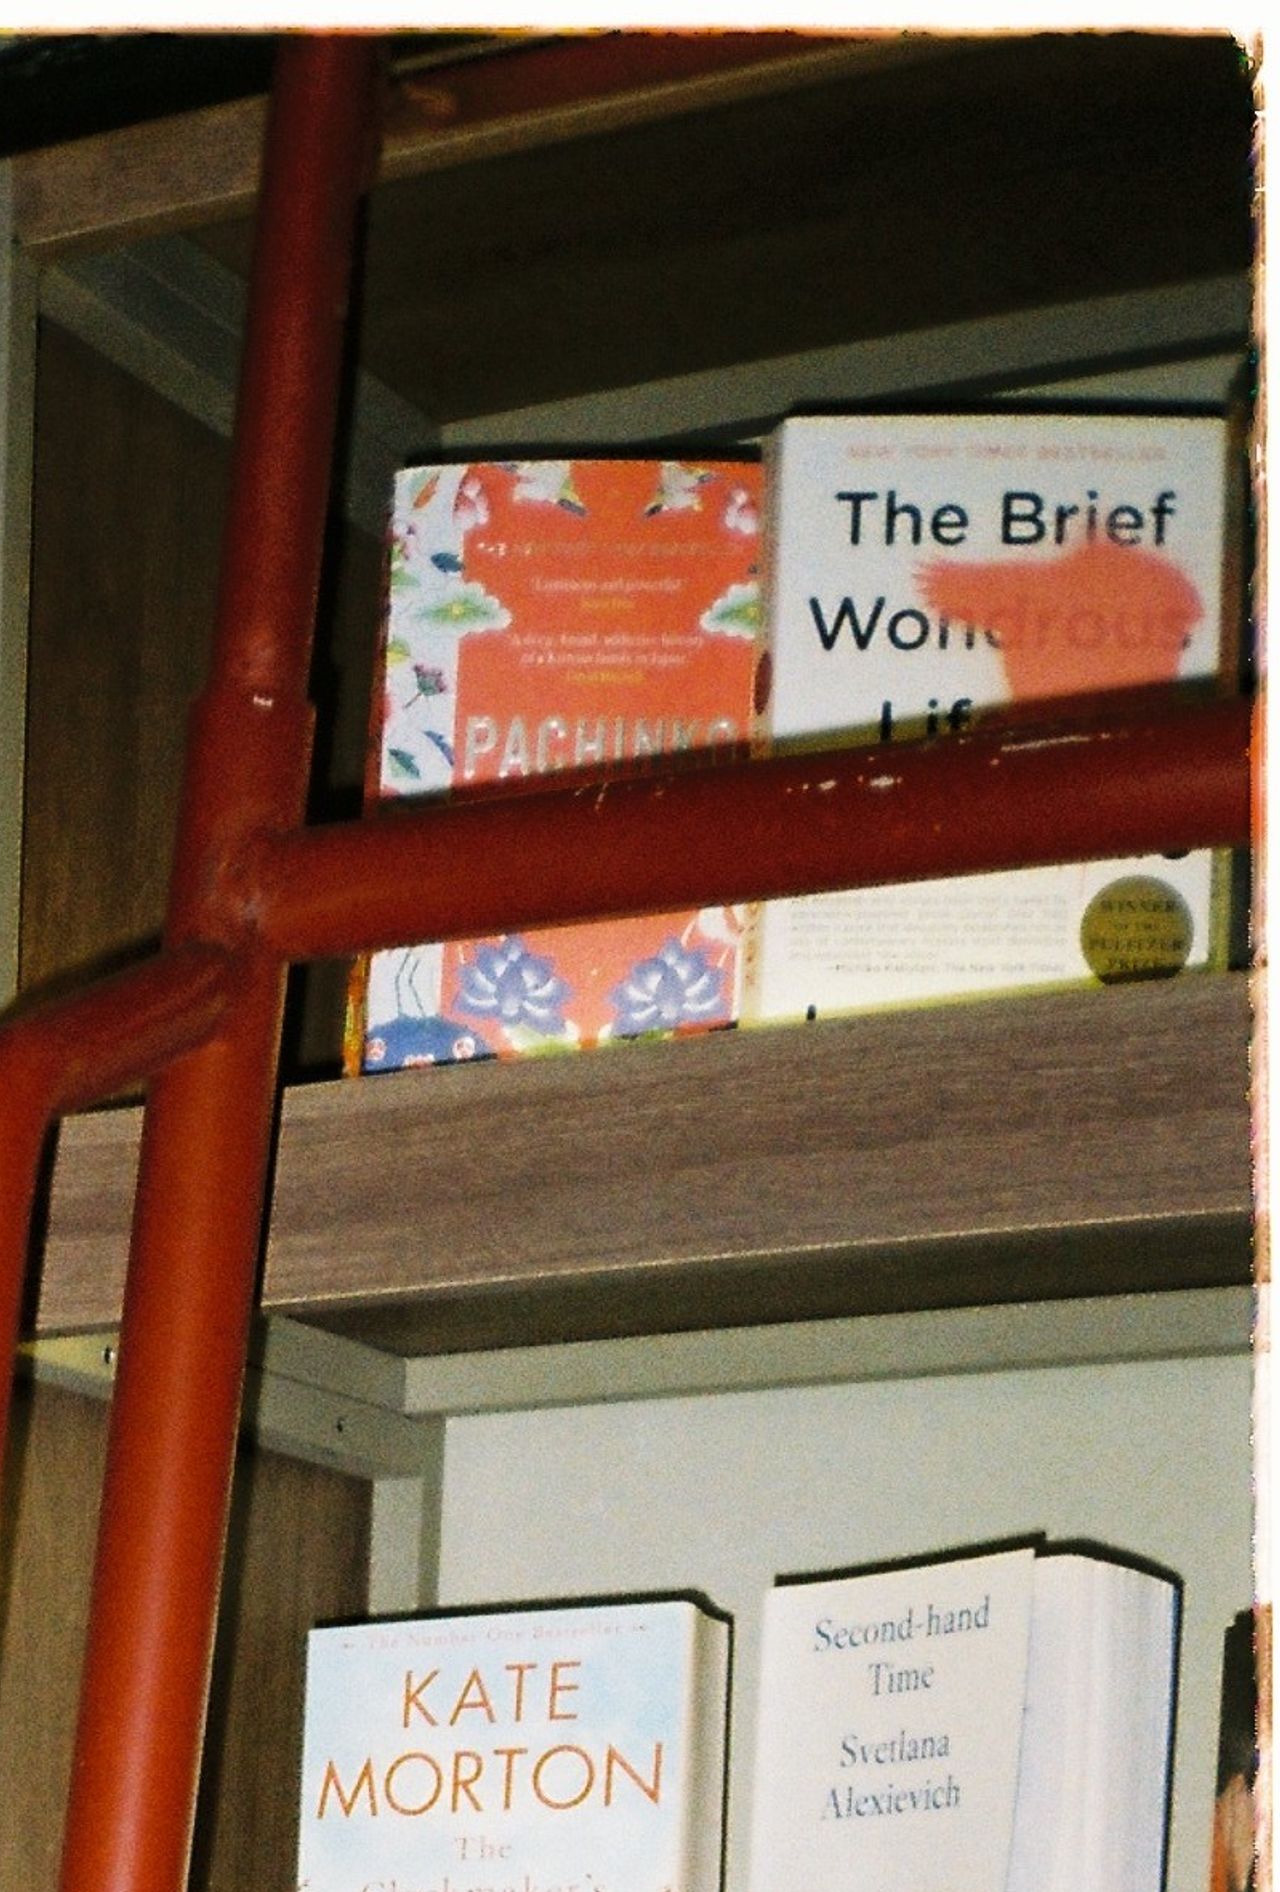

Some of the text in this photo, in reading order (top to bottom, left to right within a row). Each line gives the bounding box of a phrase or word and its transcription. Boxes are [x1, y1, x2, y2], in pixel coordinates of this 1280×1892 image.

[836, 489, 1176, 546] The Brief
[809, 596, 1192, 652] Wondrous
[463, 715, 738, 779] PACHINKO
[813, 1594, 991, 1652] Second-hand
[402, 1660, 582, 1729] KATE
[868, 1661, 935, 1697] Time
[840, 1729, 951, 1769] Svetlana
[315, 1740, 664, 1820] MORTON
[821, 1774, 961, 1821] Alexievich
[454, 1835, 513, 1861] The
